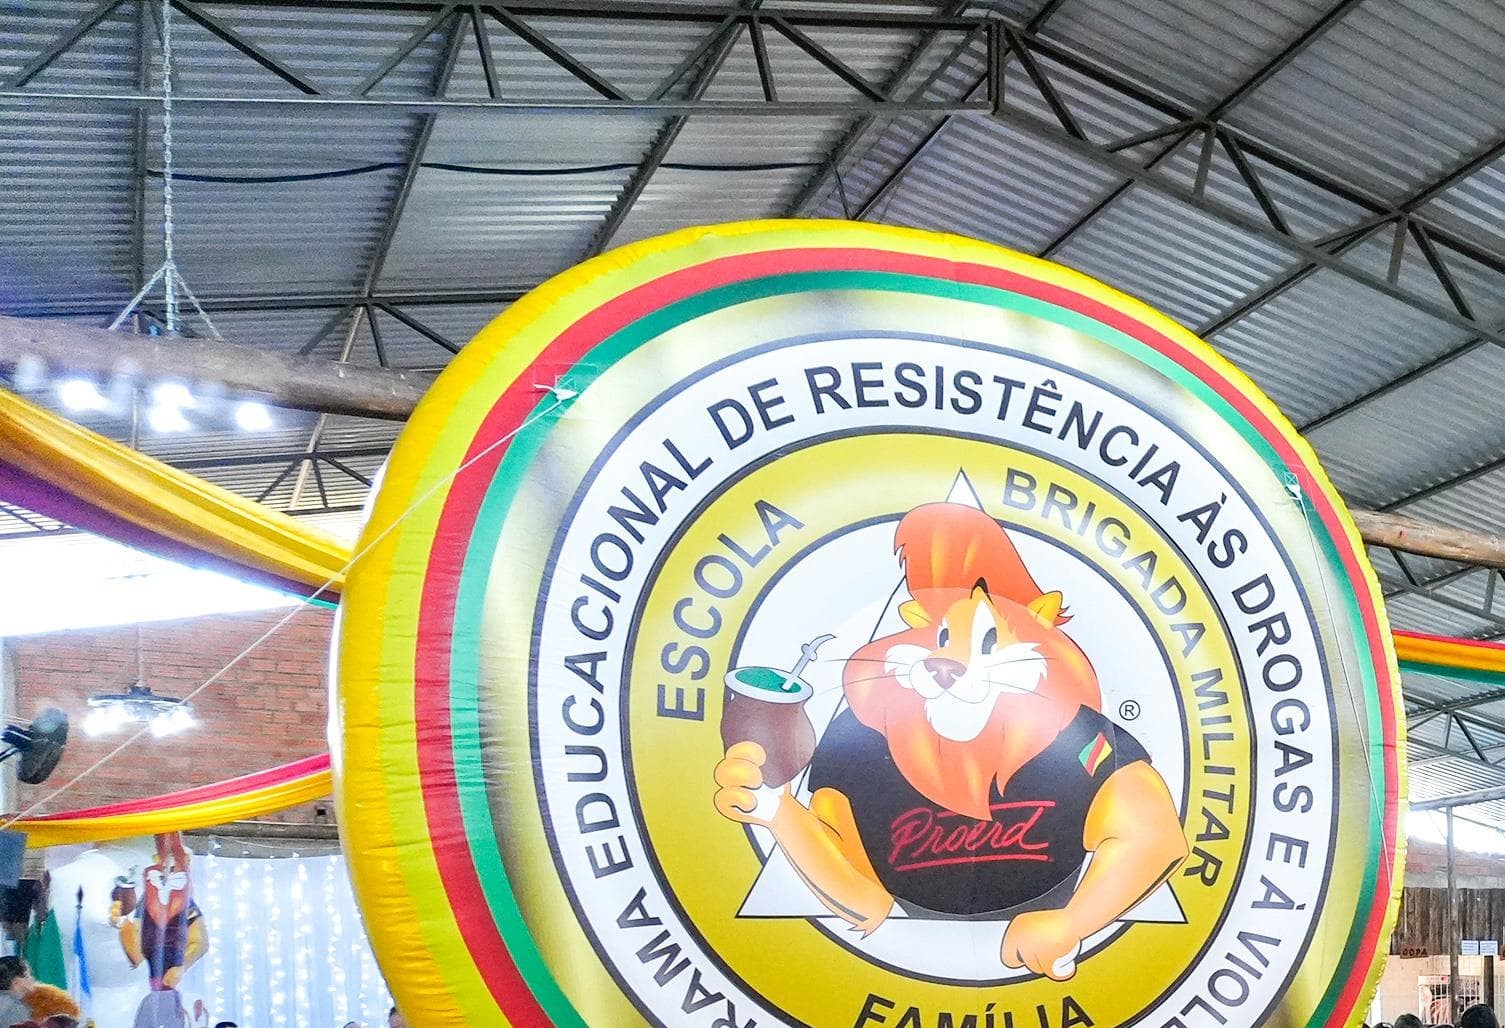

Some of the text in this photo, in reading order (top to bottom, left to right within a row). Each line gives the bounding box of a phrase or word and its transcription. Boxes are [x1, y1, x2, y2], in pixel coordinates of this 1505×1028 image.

[707, 377, 795, 450] DE
[803, 362, 1180, 504] RESISTÊNCIA
[1177, 492, 1247, 568] ÀS
[561, 438, 714, 879] EDUCACIONAL
[657, 499, 805, 722] ESCOLA
[1001, 466, 1240, 887] BRIGADA MILITAR
[1231, 573, 1313, 815] DROGAS
[887, 803, 1056, 866] Proerd
[1265, 833, 1309, 868] E
[1250, 875, 1305, 912] À
